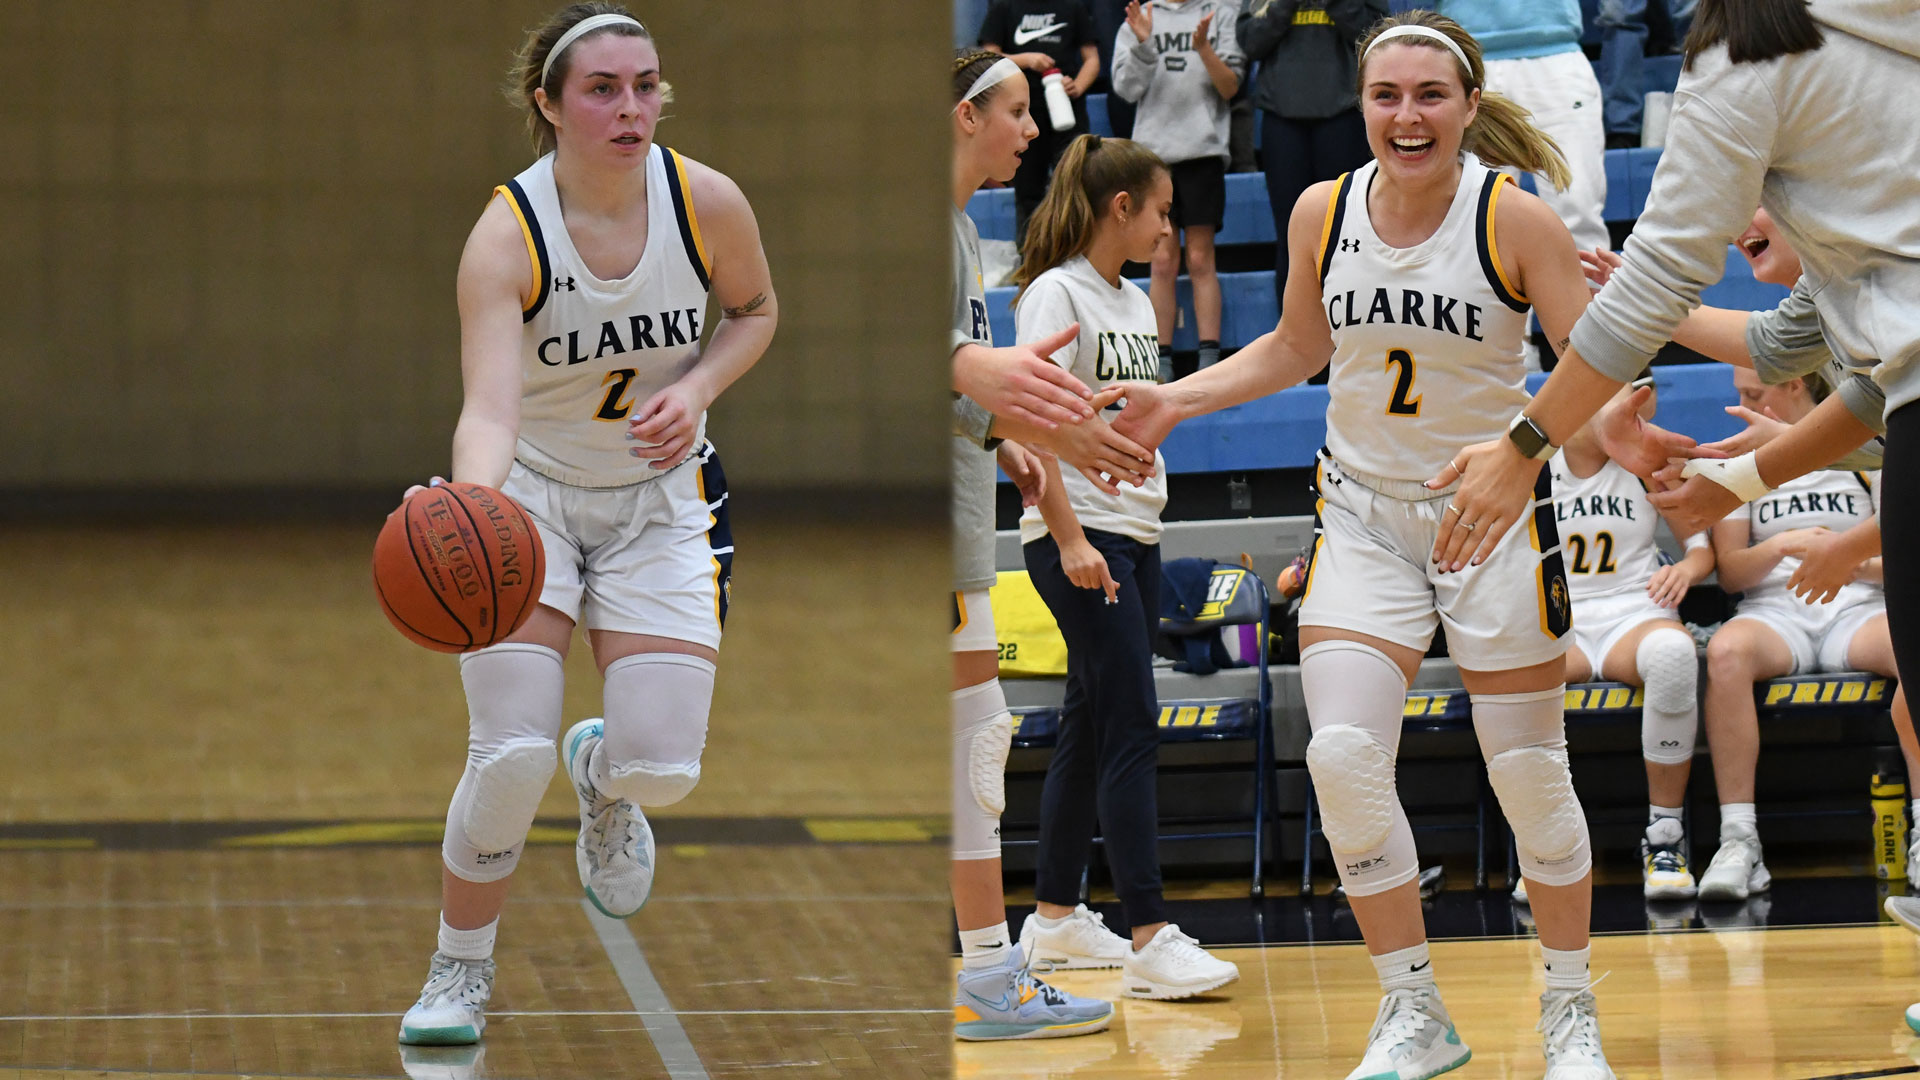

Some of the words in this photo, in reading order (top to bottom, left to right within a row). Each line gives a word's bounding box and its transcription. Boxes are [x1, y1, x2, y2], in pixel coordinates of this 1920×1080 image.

[1021, 13, 1056, 30] NIKE
[537, 308, 700, 367] CLARKE
[1329, 287, 1484, 342] CLARKE
[591, 367, 640, 423] 2
[1385, 347, 1423, 418] 2
[1557, 495, 1636, 522] LARKE
[1758, 492, 1858, 524] CLARKE
[427, 497, 480, 597] TF-1000
[460, 486, 522, 588] SPALDING
[1567, 529, 1618, 576] 22
[1157, 705, 1222, 728] IDE
[1764, 680, 1887, 705] PRIDE
[1346, 855, 1386, 870] HEX
[1882, 814, 1896, 864] CLARKE
